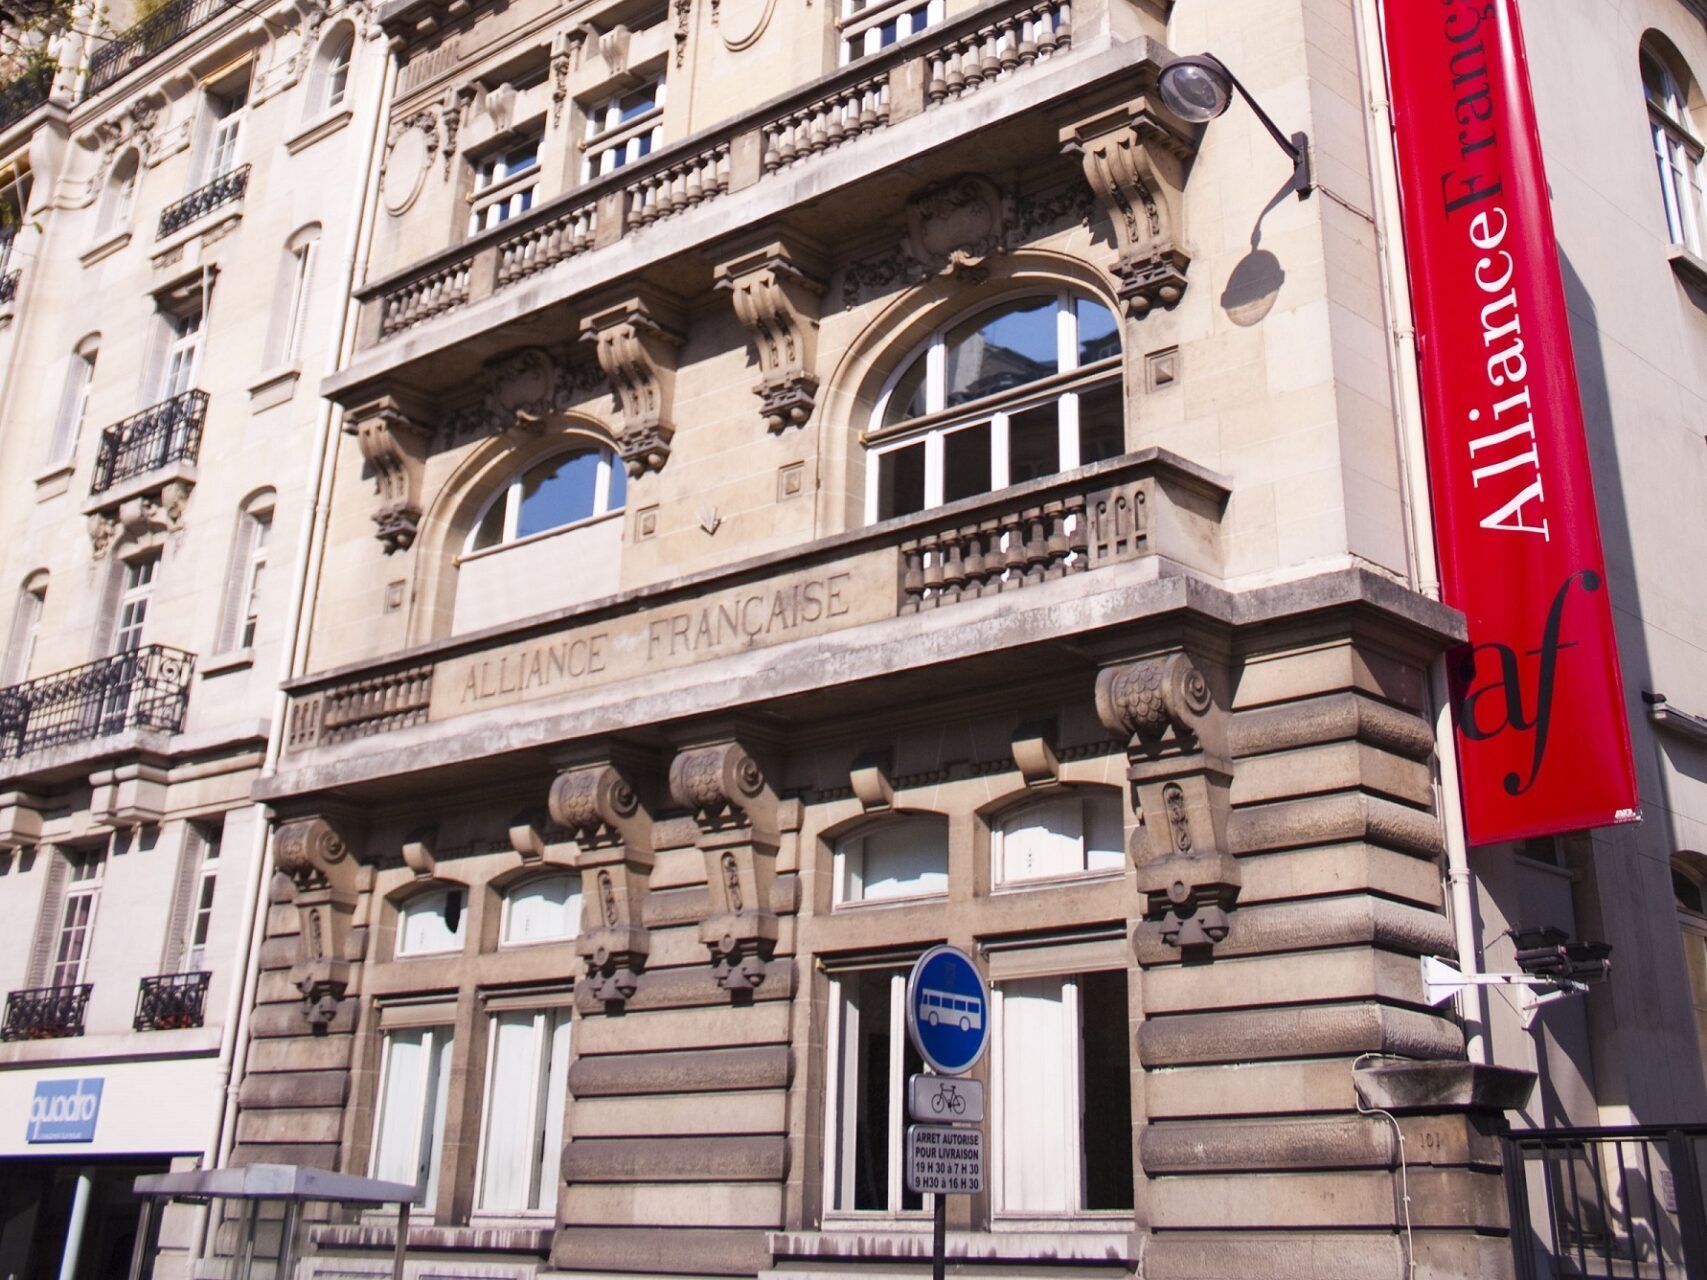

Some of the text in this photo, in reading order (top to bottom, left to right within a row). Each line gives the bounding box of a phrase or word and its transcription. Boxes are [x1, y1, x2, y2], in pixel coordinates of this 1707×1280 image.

[1468, 206, 1549, 543] Alliance
[461, 572, 852, 703] ALLIANCE FRANÇAISE
[916, 1132, 979, 1145] ARRET AUTORISE
[915, 1147, 979, 1160] POUR LIVRAISON
[935, 1162, 945, 1174] 30
[969, 1164, 979, 1175] 30
[969, 1178, 979, 1190] 30
